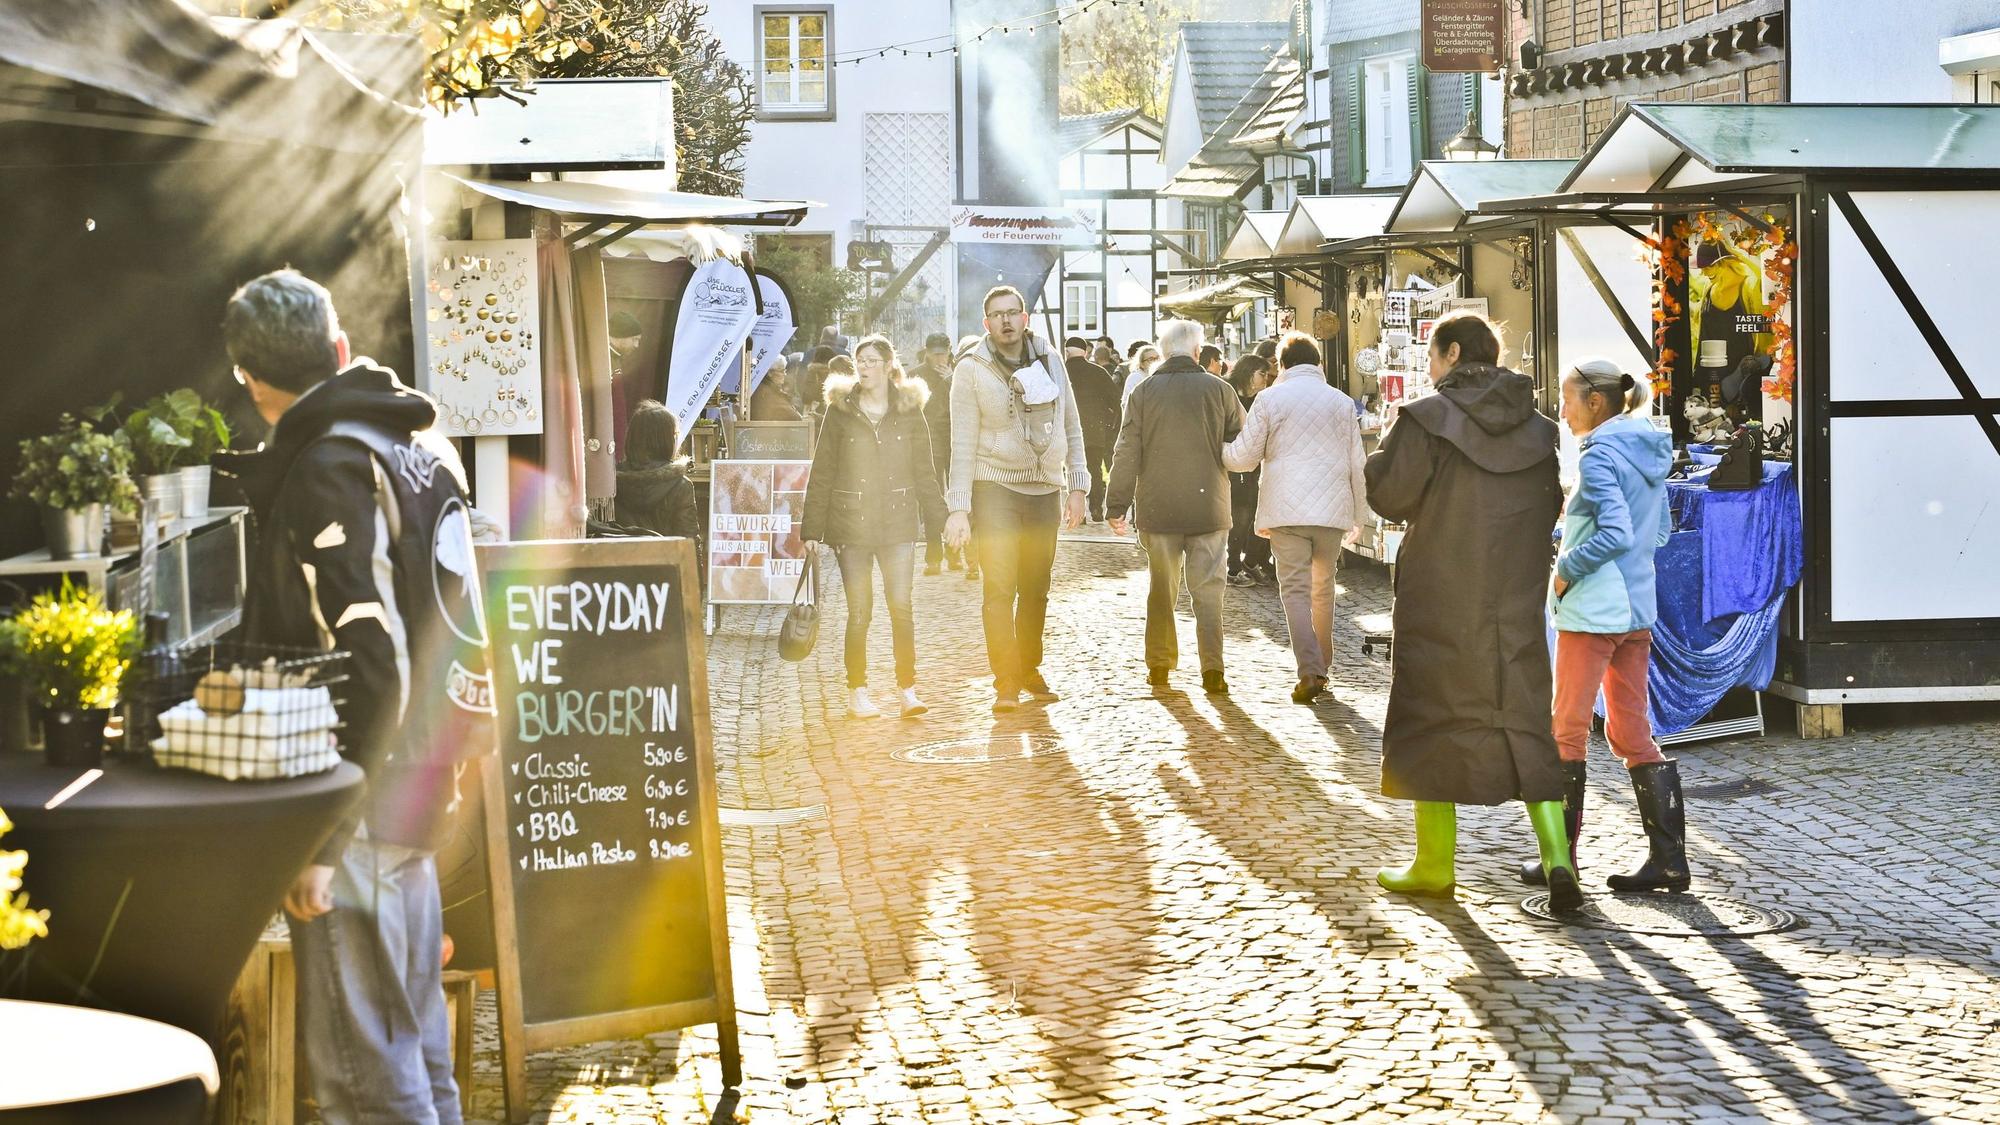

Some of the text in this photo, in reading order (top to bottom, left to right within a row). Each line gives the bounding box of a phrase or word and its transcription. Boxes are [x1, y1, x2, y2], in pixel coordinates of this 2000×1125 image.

[1432, 14, 1464, 22] Geländer
[1472, 14, 1494, 22] Zäune
[1435, 38, 1492, 46] Überdachungen
[982, 231, 1063, 241] der Feuerwehr
[1735, 315, 1762, 323] TASTE
[1735, 324, 1760, 333] FEEL
[698, 339, 733, 389] GENIESSER
[715, 541, 766, 552] AUS ALLER
[506, 581, 669, 635] EVERYDAY
[511, 639, 563, 685] WE
[524, 752, 591, 780] Classic
[527, 781, 628, 807] Chili-Cheese
[530, 810, 579, 842] BBQ
[534, 846, 588, 871] Italian
[591, 839, 637, 865] Pesto
